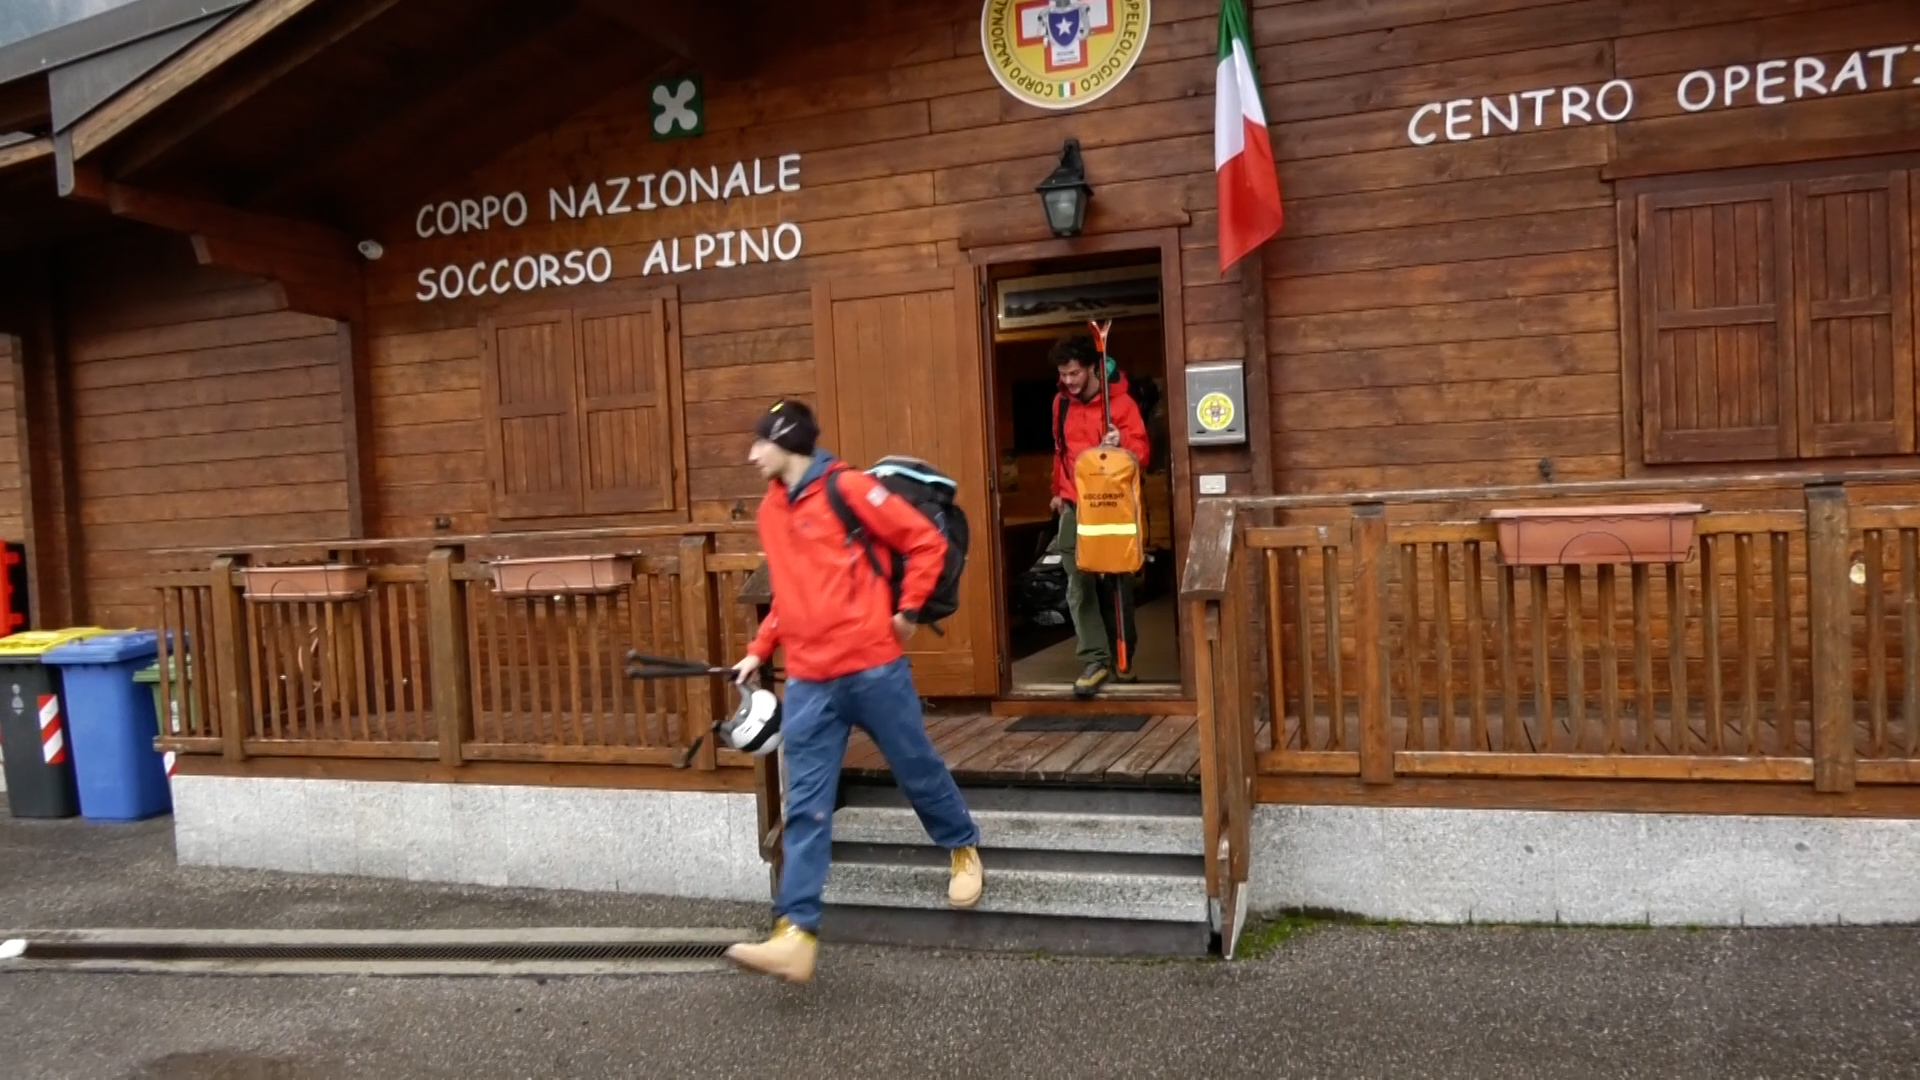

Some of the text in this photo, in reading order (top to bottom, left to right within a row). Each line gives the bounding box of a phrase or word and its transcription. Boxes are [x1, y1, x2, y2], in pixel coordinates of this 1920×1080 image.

[1009, 67, 1053, 97] CORPO
[1080, 0, 1140, 92] PELEOLOGICO
[1407, 79, 1635, 146] CENTRO
[415, 190, 528, 238] CORPO
[549, 153, 803, 222] NAZIONALE
[416, 221, 804, 302] SOCCORSO ALPINO
